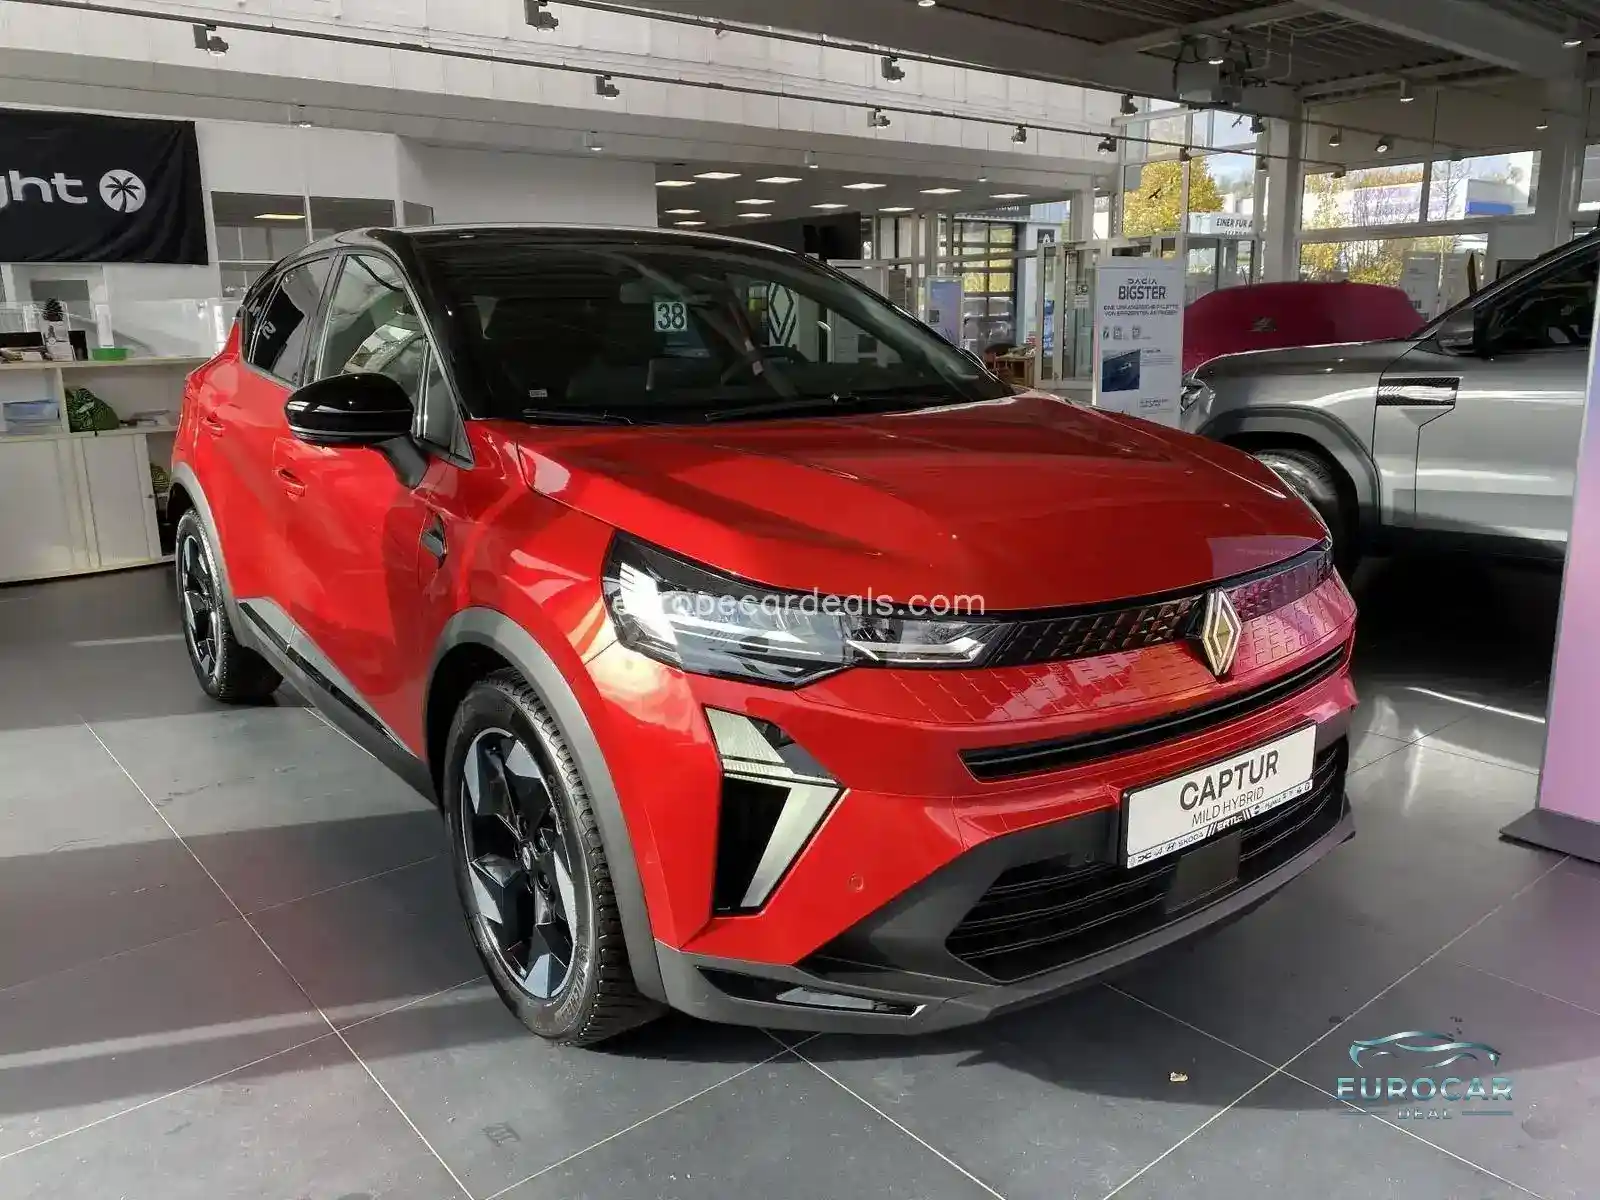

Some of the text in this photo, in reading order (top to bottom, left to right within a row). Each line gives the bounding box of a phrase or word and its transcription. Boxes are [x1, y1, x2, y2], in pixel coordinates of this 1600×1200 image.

[0, 170, 88, 210] ht
[1118, 285, 1166, 300] BIGSTER
[657, 303, 686, 330] 38
[1179, 749, 1280, 811] CAPTUR
[1191, 805, 1221, 828] MILD
[1223, 786, 1264, 814] HYBRID
